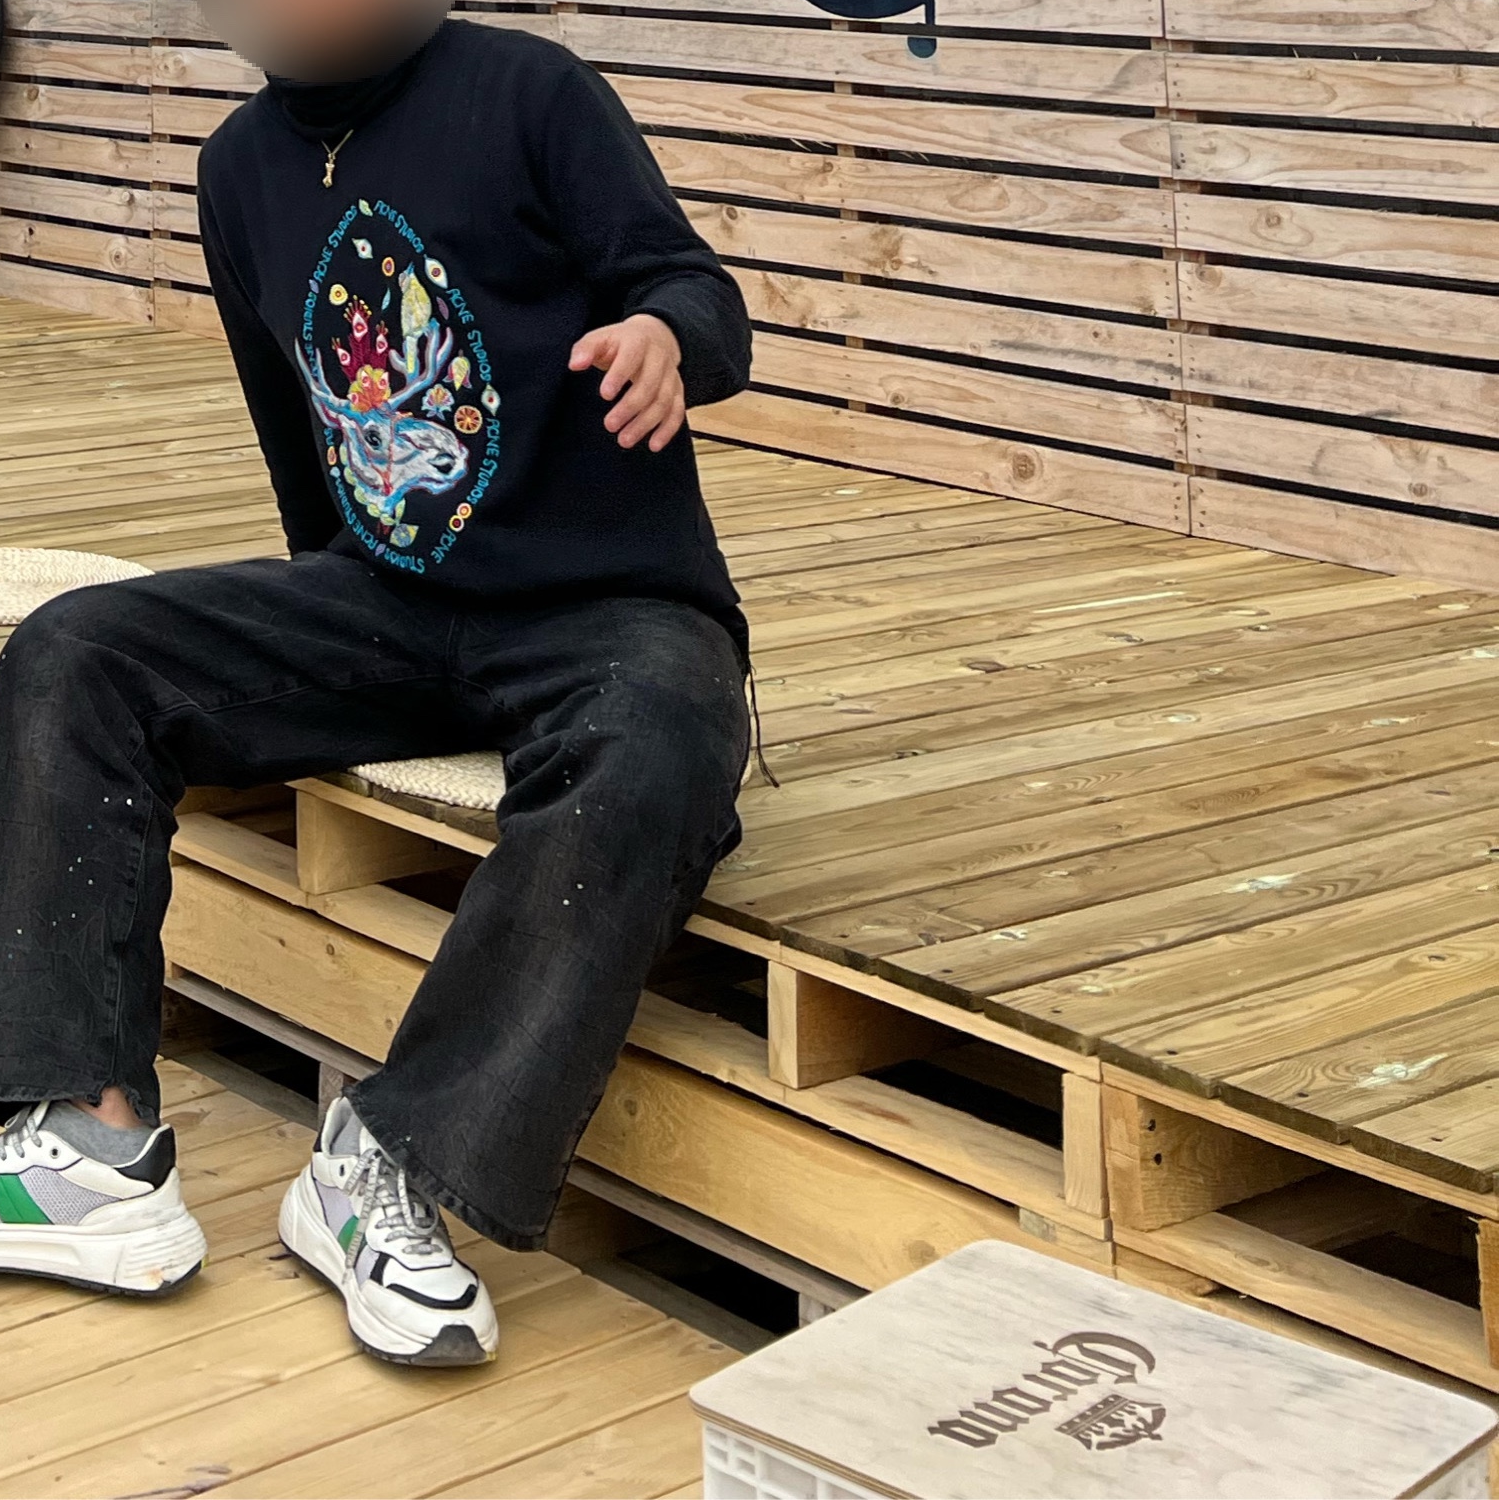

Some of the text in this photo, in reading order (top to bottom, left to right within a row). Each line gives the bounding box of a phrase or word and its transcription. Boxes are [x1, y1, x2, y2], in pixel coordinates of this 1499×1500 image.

[313, 205, 358, 284] ACNE STUDIOS
[446, 288, 492, 382] ACNE STUDIOS
[466, 417, 501, 505] ACNE STUDIOS
[352, 519, 379, 551] ACNE
[384, 528, 457, 574] ACNE STUDIOS
[927, 1331, 1156, 1448] Corona
